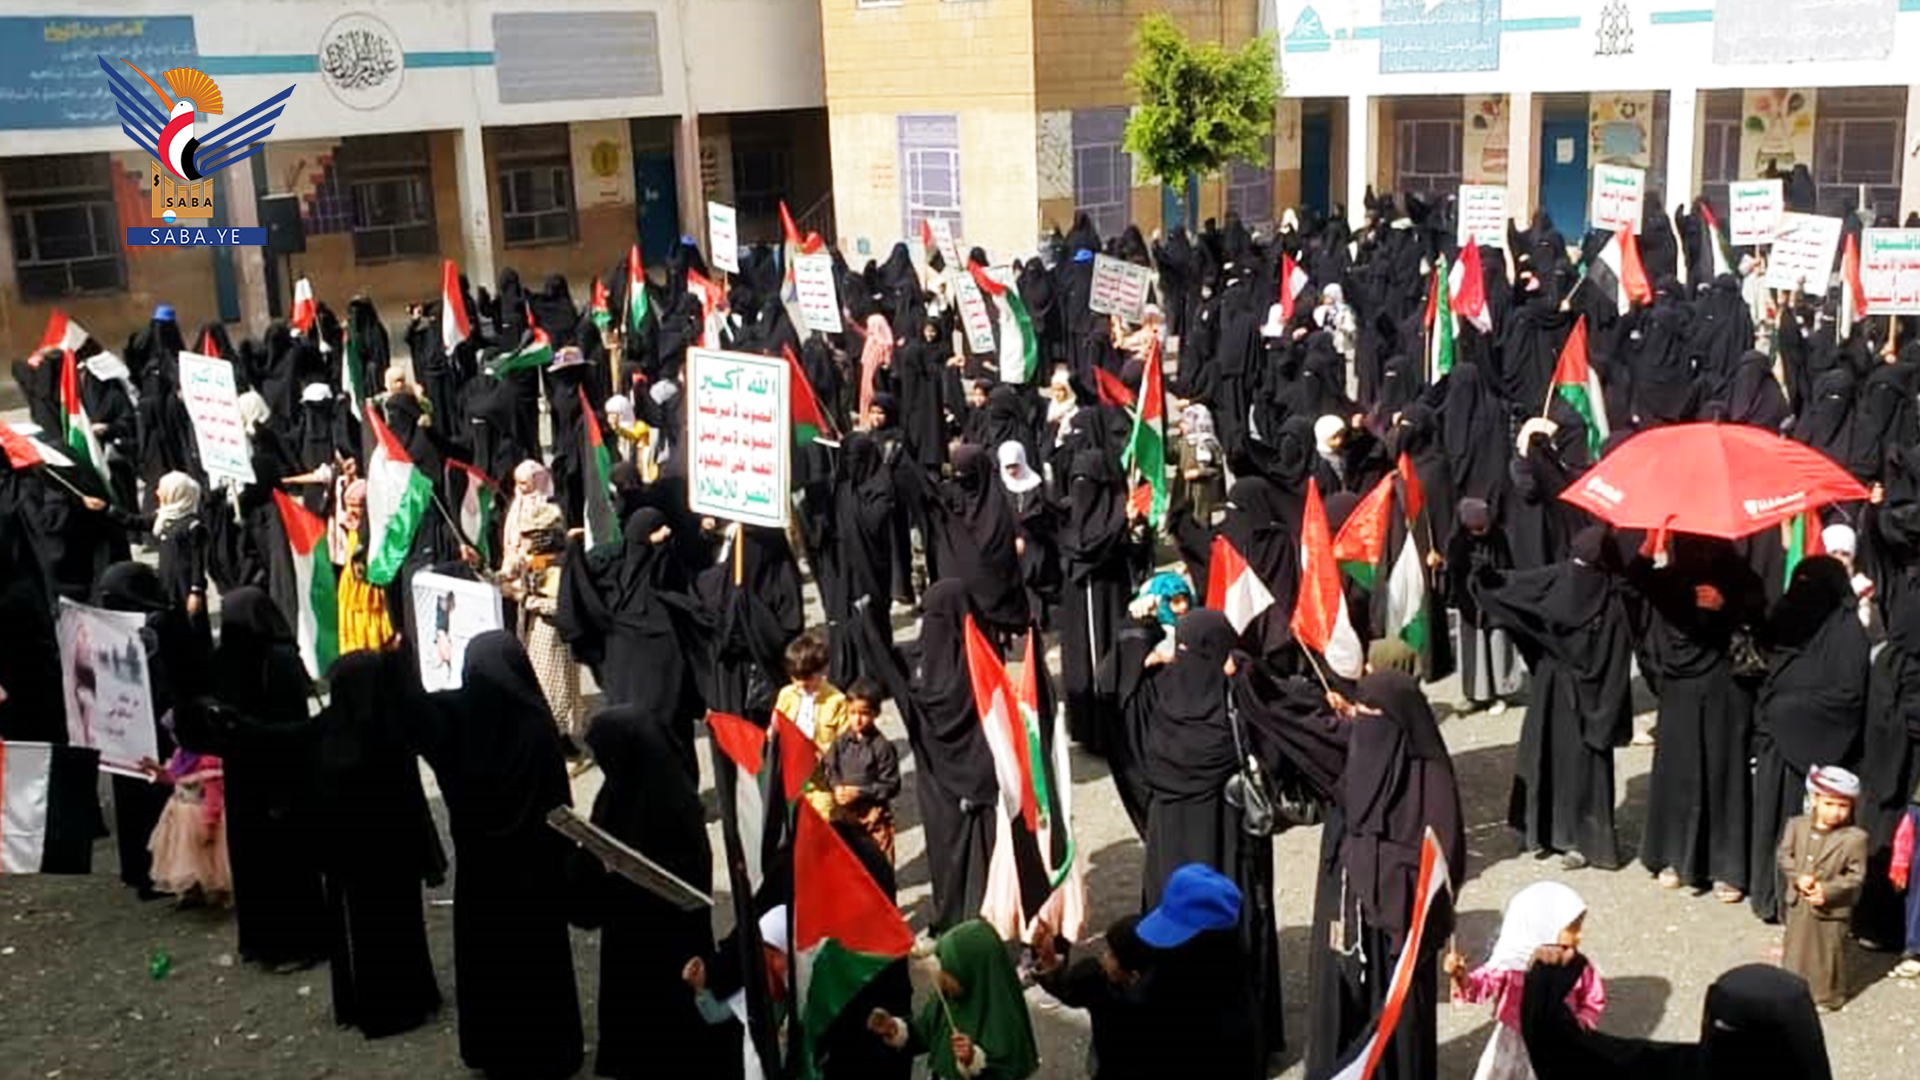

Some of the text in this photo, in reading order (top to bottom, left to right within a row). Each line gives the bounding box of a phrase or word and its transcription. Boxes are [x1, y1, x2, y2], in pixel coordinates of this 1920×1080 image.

[699, 365, 776, 396] الله أكبر
[742, 406, 776, 425] الموت
[742, 432, 776, 451] الموت
